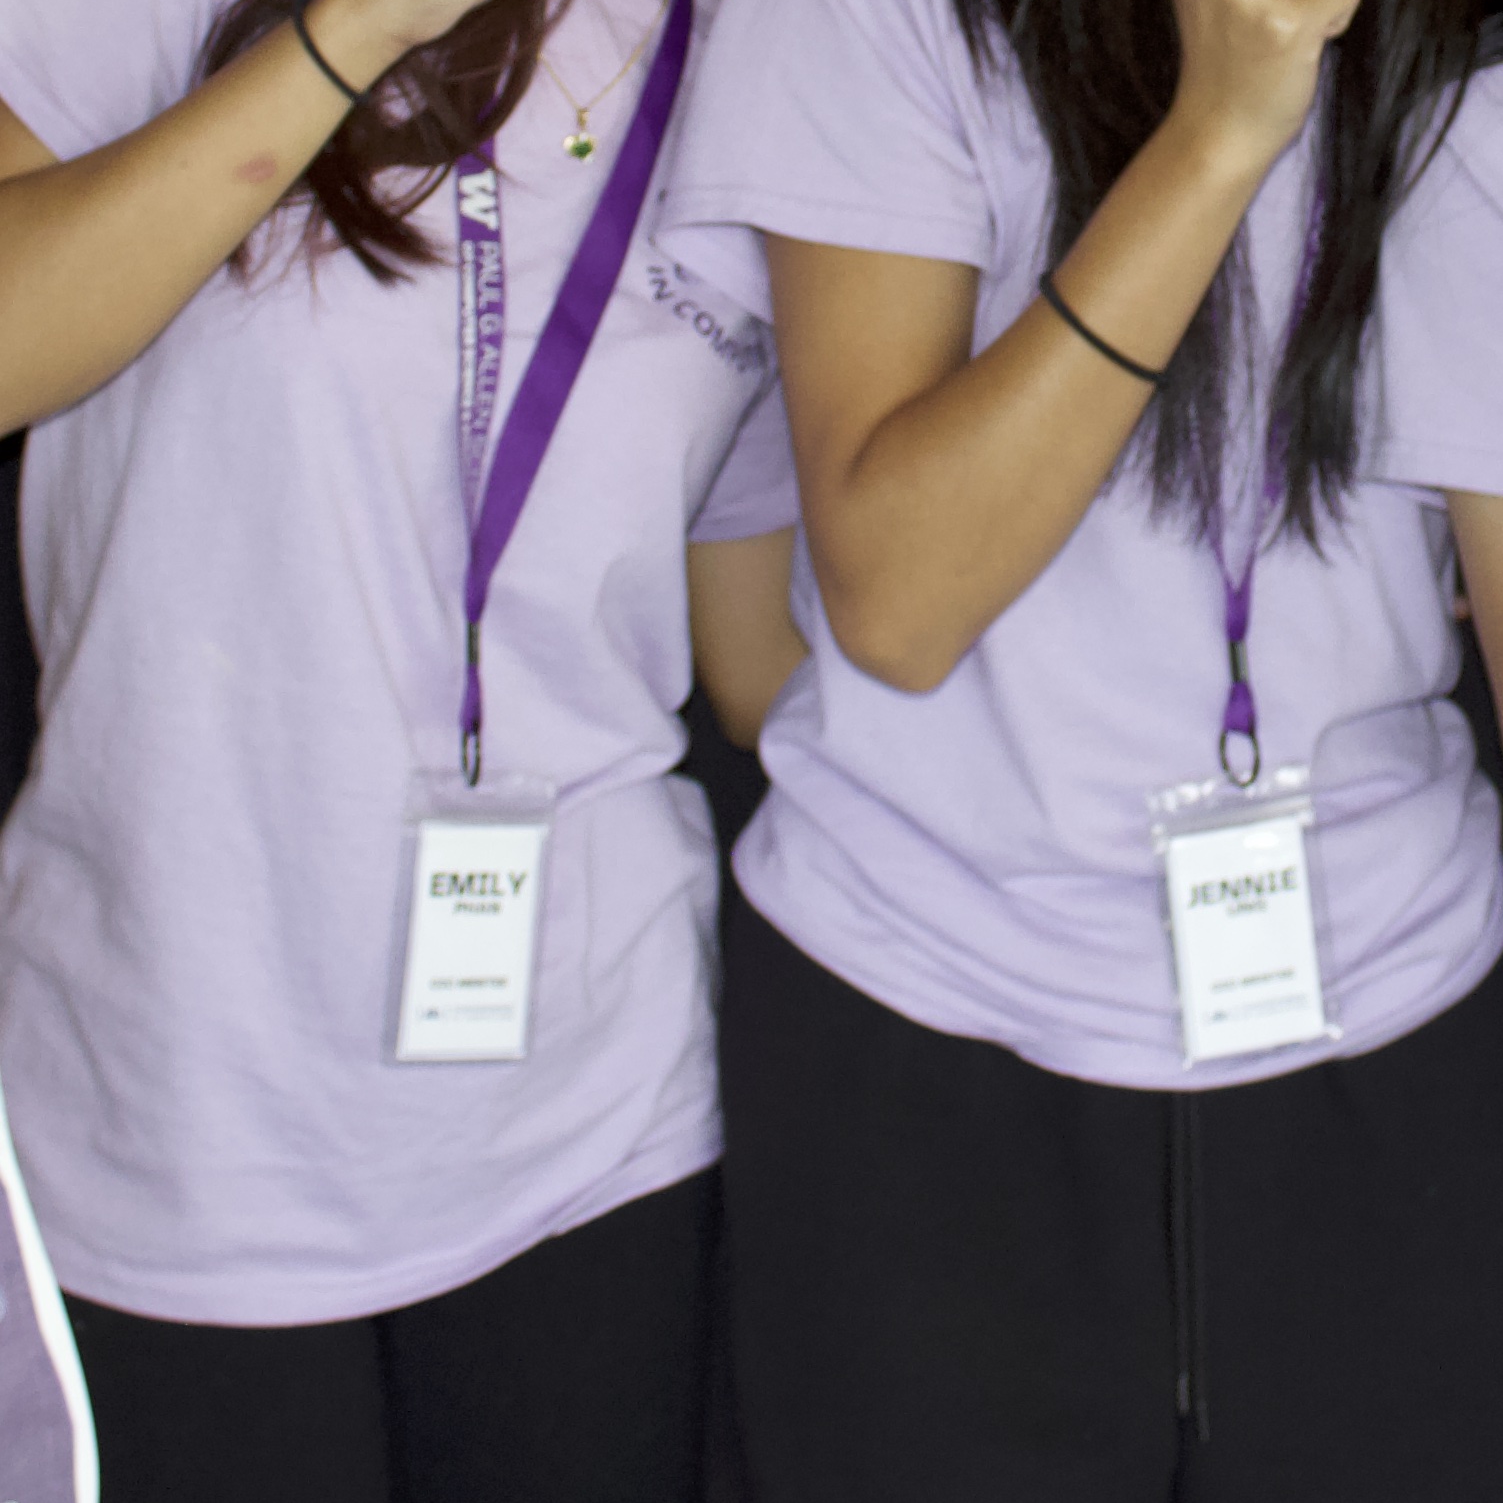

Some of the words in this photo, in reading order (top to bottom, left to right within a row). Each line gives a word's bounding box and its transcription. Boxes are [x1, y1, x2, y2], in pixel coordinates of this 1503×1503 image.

[458, 169, 500, 230] W
[476, 240, 503, 309] PAUL
[429, 871, 528, 898] EMILY
[1188, 866, 1298, 908] JENNIE
